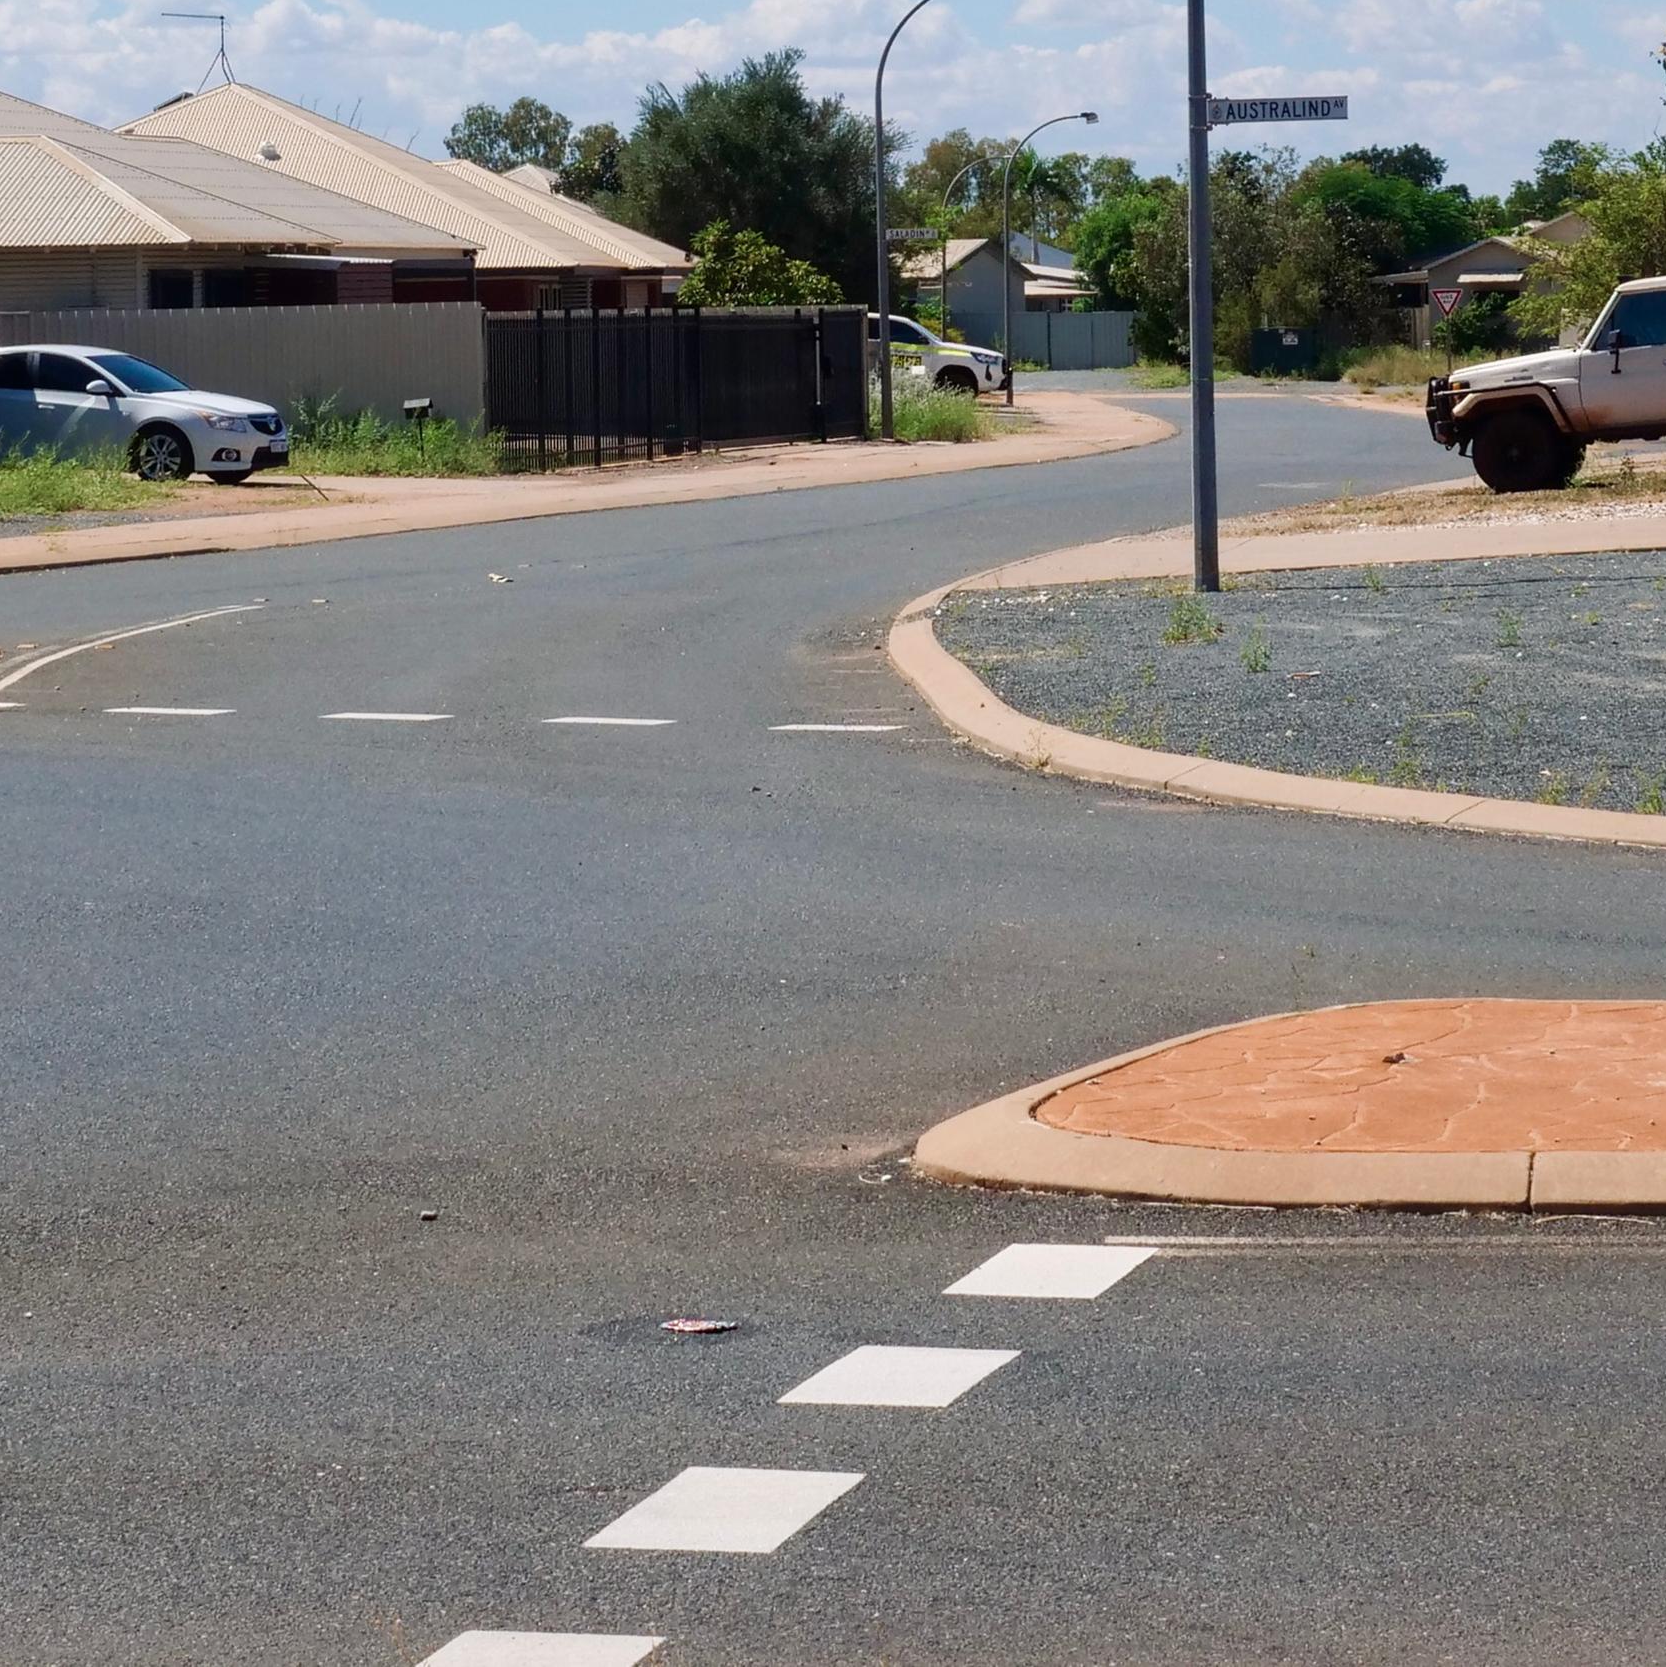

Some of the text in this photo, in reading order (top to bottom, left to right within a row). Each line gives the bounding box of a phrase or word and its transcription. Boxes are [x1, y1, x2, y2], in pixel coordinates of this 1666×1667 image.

[1226, 99, 1345, 119] AUSTRALIND AV
[889, 229, 925, 239] SALADIN
